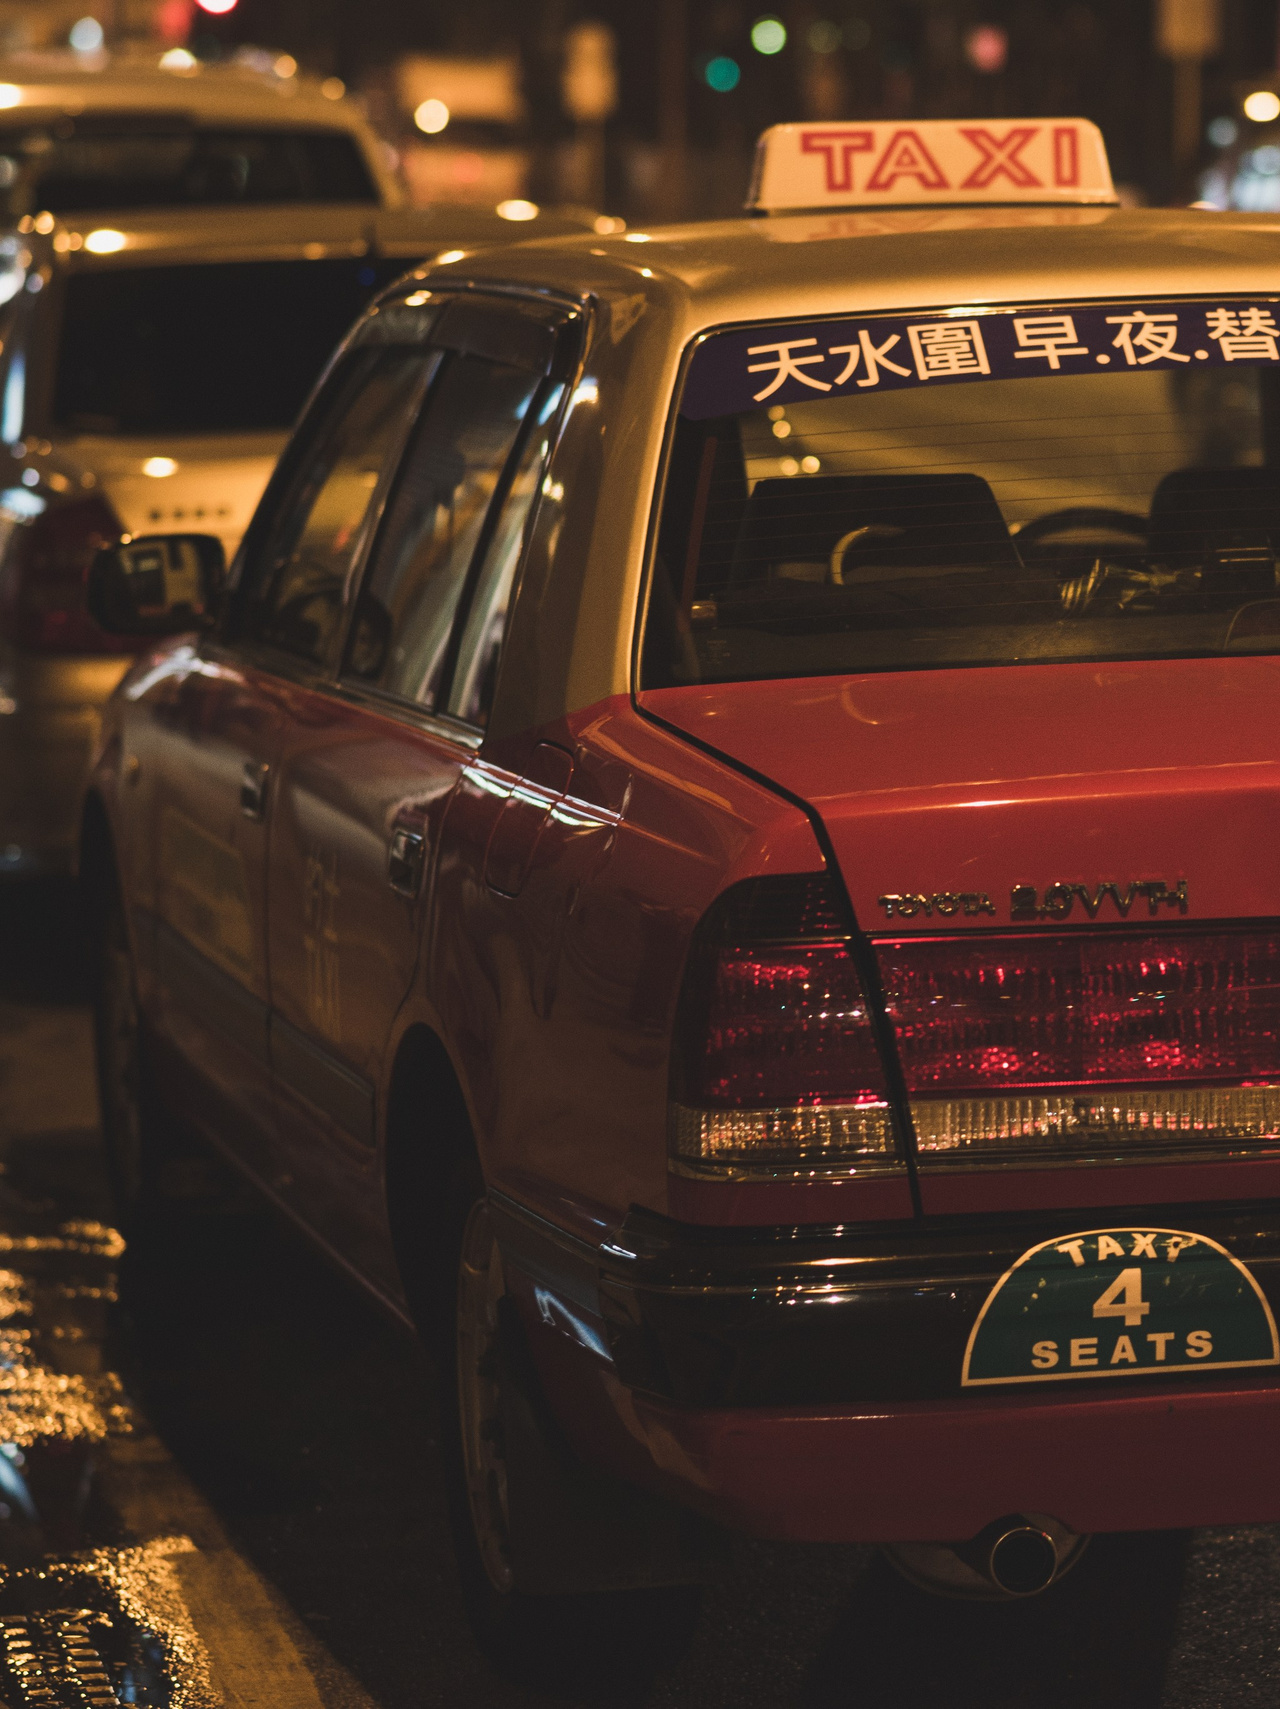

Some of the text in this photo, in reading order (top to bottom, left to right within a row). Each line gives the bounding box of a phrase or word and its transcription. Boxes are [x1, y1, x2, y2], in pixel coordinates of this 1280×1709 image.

[801, 127, 1079, 192] TAXI
[747, 319, 992, 402] 天水圍
[878, 892, 996, 918] TOYOTA
[1056, 1232, 1184, 1268] TAXI
[1092, 1267, 1150, 1327] 4
[1031, 1329, 1214, 1369] SEATS
